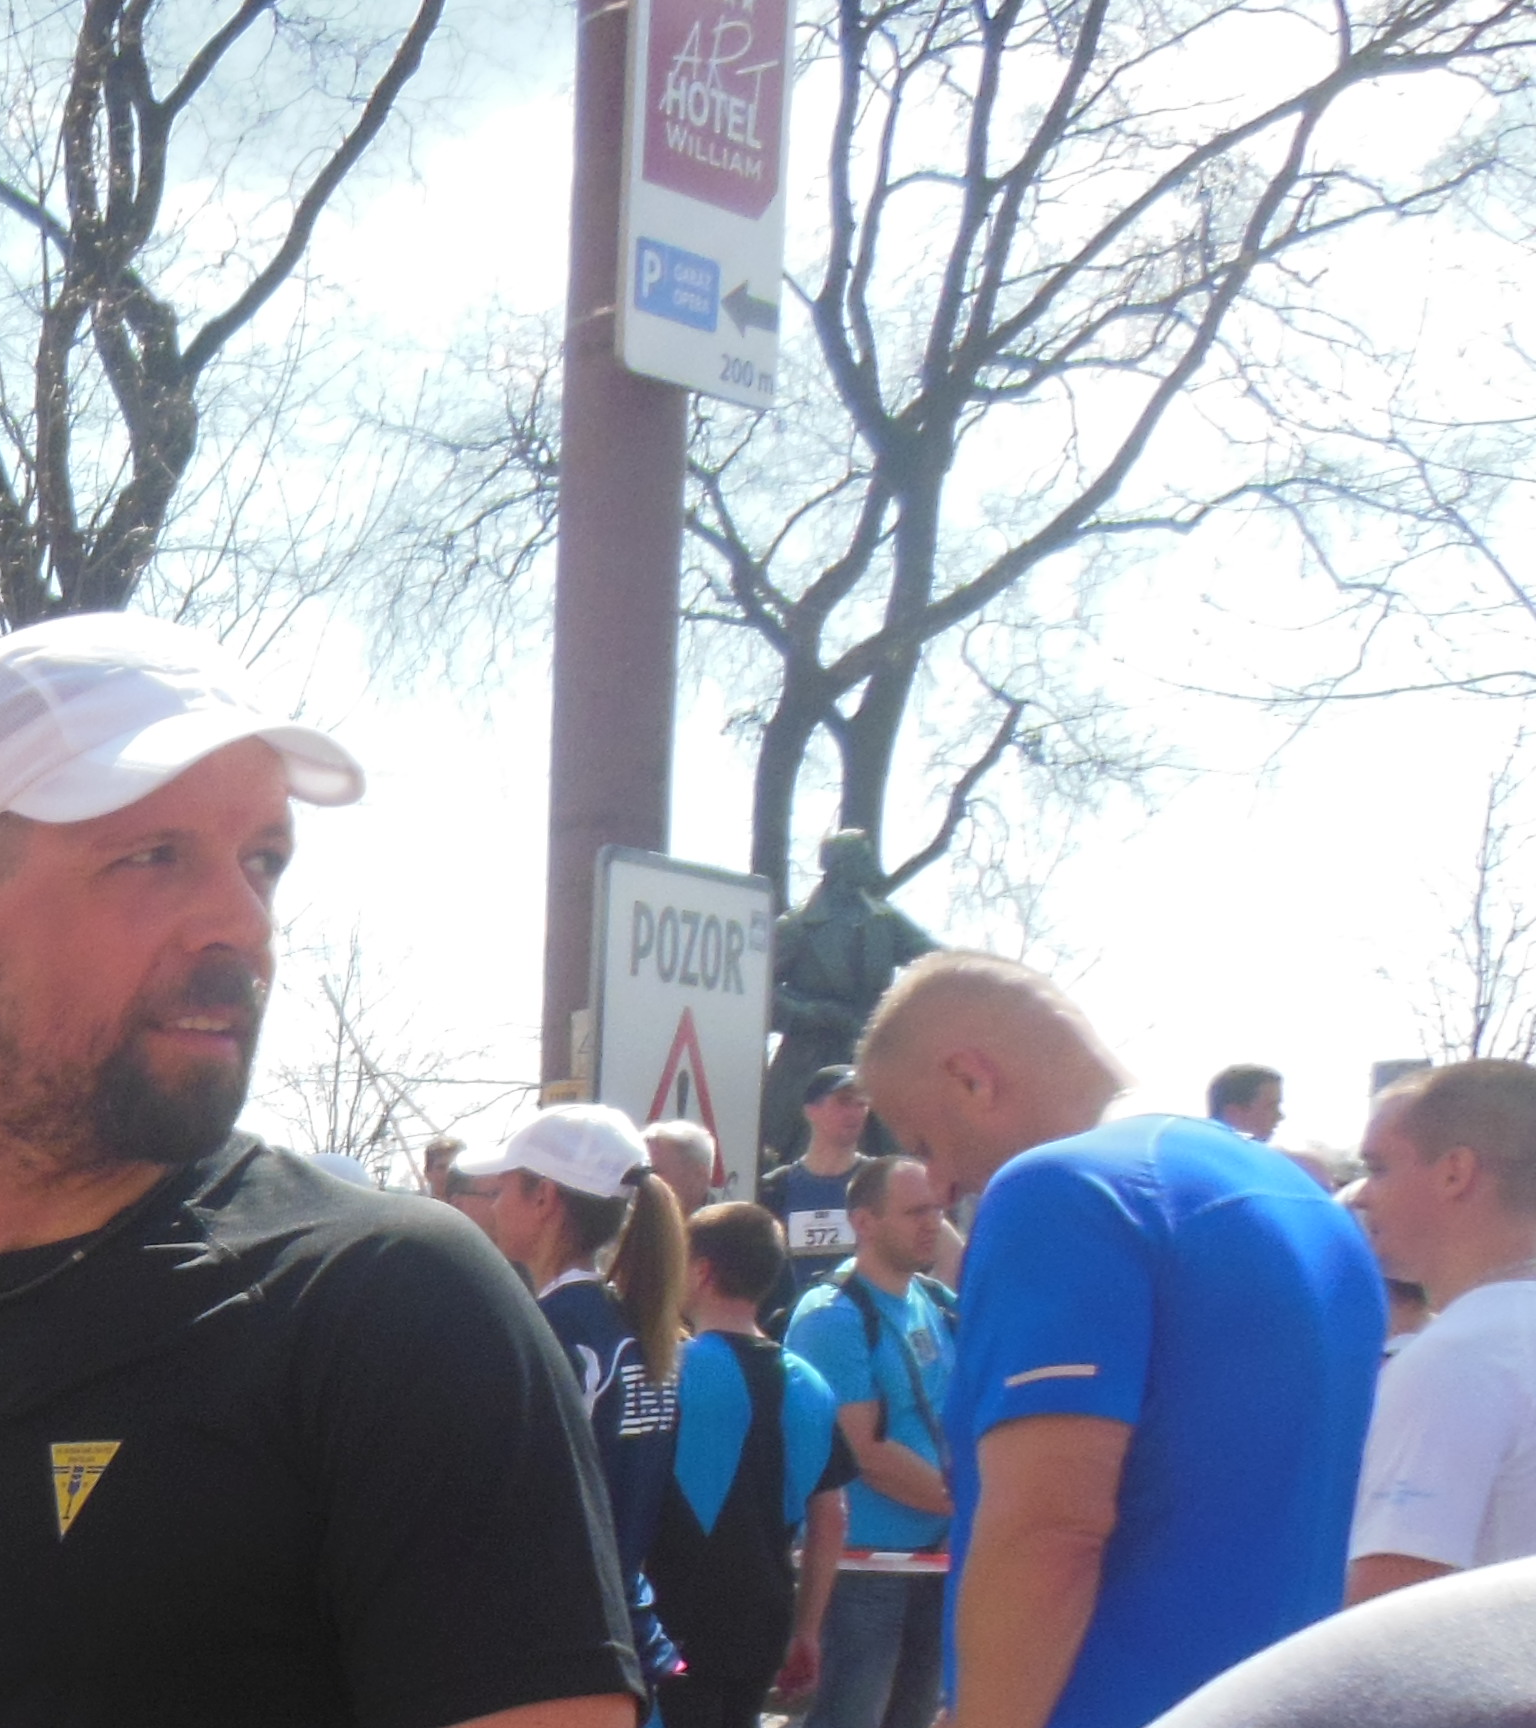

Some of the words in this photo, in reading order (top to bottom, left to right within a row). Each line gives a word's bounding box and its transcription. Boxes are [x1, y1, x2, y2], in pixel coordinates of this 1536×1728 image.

[659, 15, 779, 110] ART
[664, 72, 762, 149] HOTEL
[665, 121, 762, 181] WILLIAM
[642, 249, 662, 298] P
[720, 353, 754, 388] 200
[757, 371, 775, 396] m
[630, 900, 744, 995] POZOR
